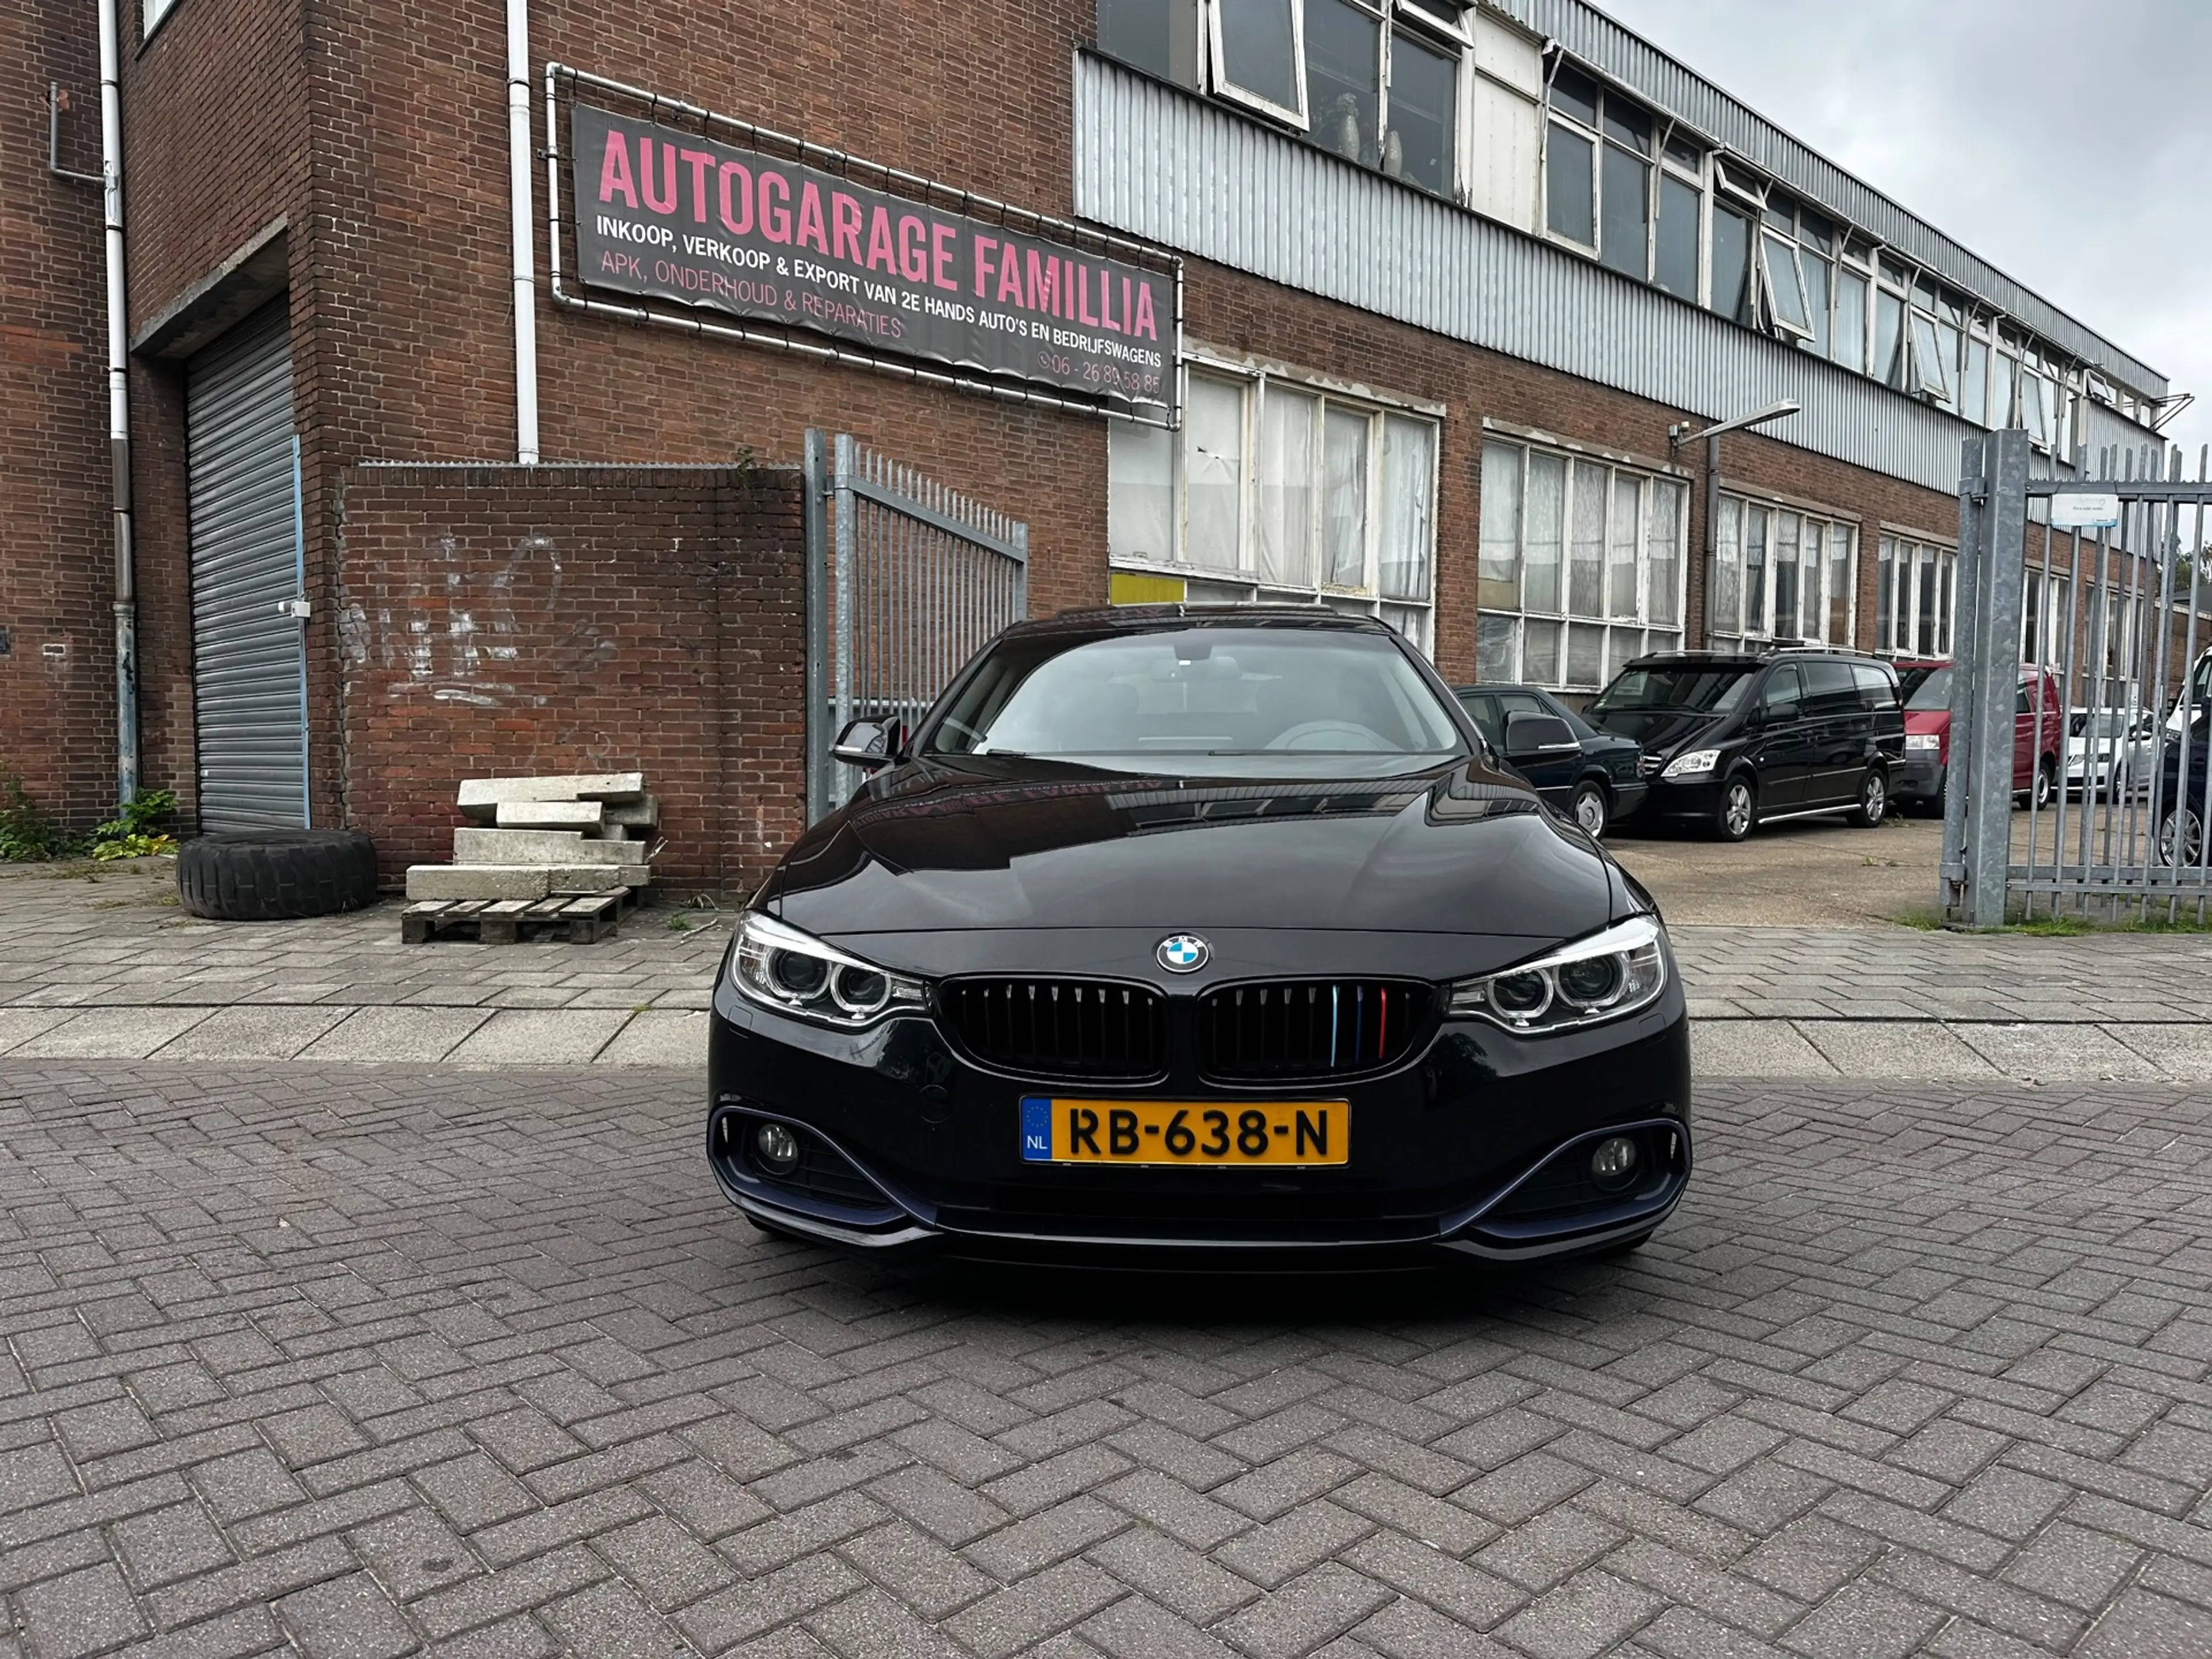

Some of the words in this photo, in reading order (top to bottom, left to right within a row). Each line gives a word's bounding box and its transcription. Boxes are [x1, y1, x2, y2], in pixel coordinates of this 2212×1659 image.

[599, 129, 958, 291] AUTOGARAGE
[974, 234, 1158, 341] FAMILLIA
[596, 214, 677, 253] INKOOP,
[682, 234, 771, 270] VERKOOP
[775, 256, 790, 276] &
[794, 259, 860, 294] EXPORT
[864, 281, 896, 305] VAN
[901, 291, 921, 312] 2E
[925, 296, 975, 323] HANDS
[979, 310, 1028, 337] AUTO'S
[1032, 322, 1050, 340] EN
[1053, 328, 1162, 368] BEDRIJFSWAGENS
[601, 250, 648, 283] APK,
[655, 260, 778, 306] ONDERHOUD
[783, 290, 797, 311] &
[802, 291, 902, 339] REPARATIES
[1051, 354, 1070, 376] 06
[1083, 361, 1100, 382] 26
[1124, 370, 1140, 391] 58
[1027, 1135, 1048, 1150] NL
[1069, 1108, 1328, 1156] RB-638-N
